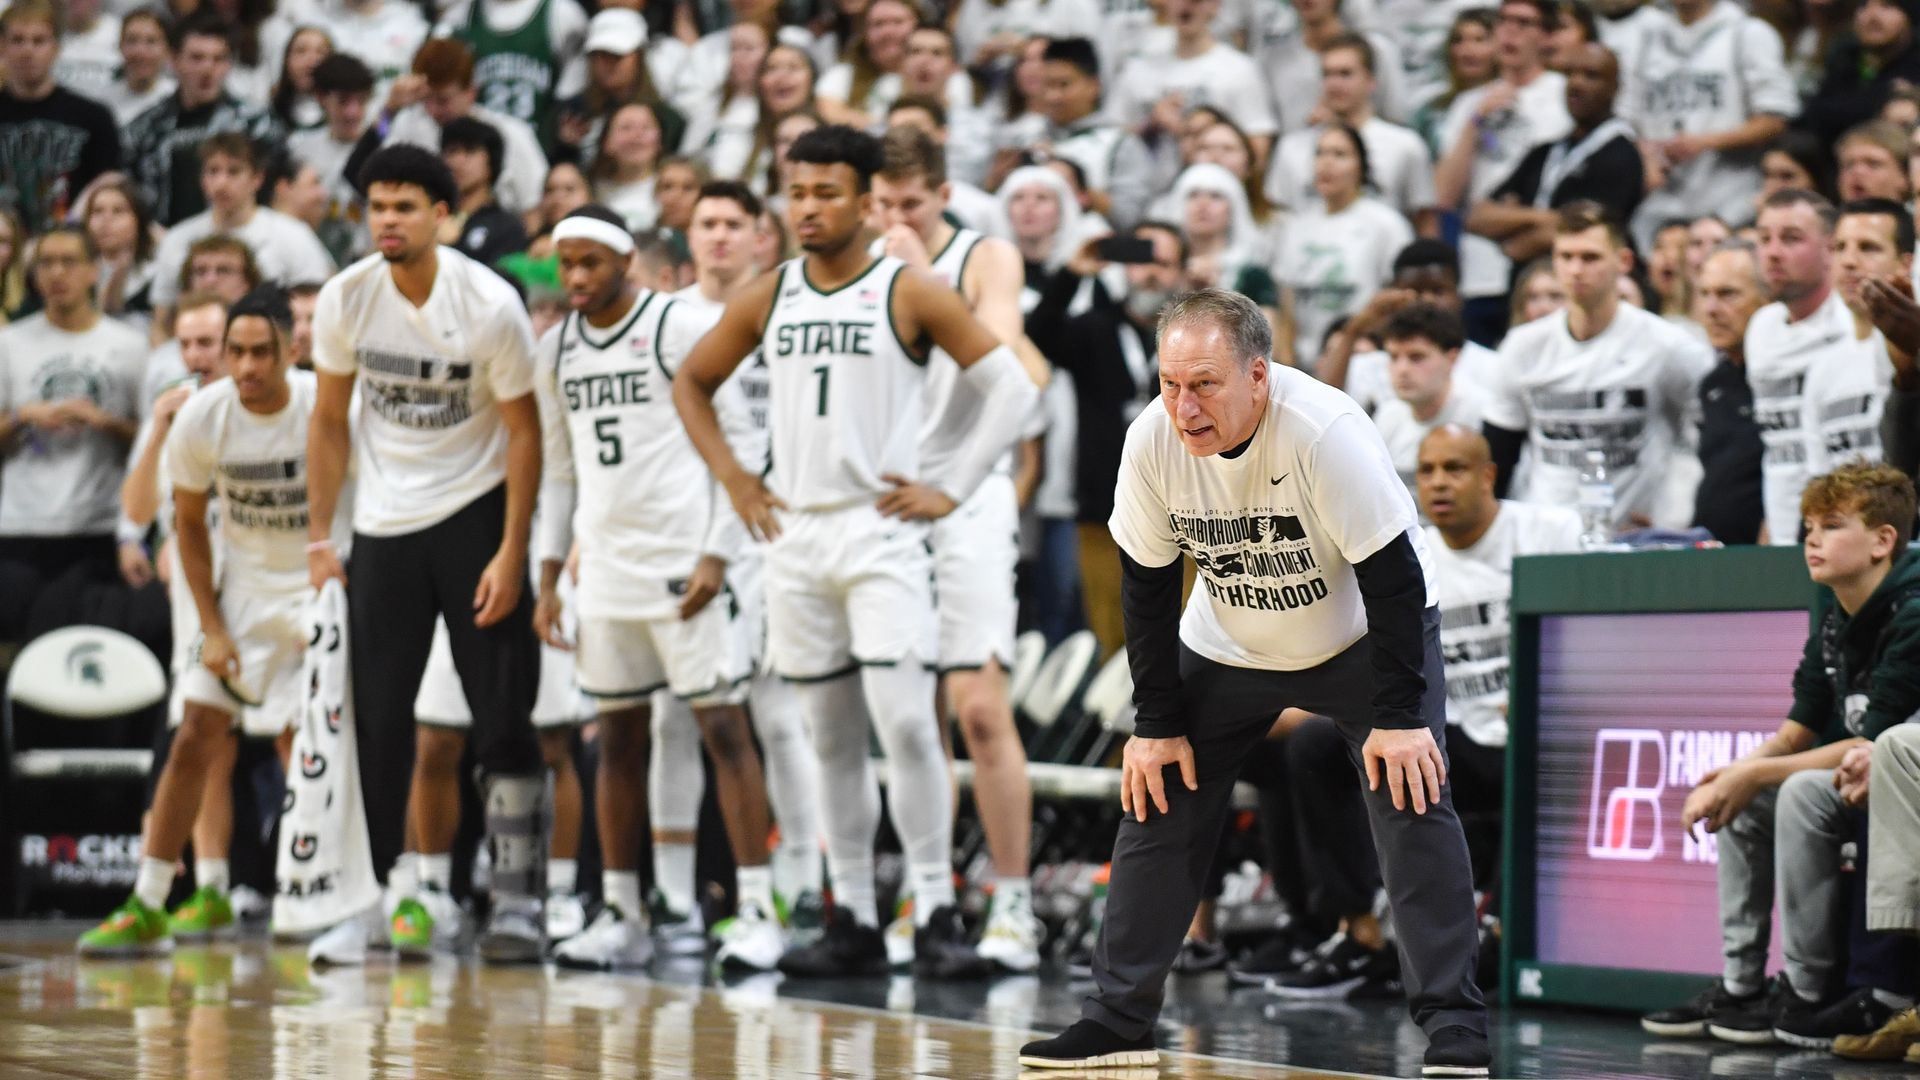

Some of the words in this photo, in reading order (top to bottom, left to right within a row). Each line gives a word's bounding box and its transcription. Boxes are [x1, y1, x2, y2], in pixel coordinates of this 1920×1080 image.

[777, 321, 875, 357] STATE
[564, 369, 653, 411] STATE
[812, 366, 830, 416] 1
[595, 416, 622, 466] 5
[1169, 513, 1250, 548] EGHBRHOOD
[1204, 577, 1333, 612] OTHERHOOD.
[21, 834, 143, 866] ROCKE
